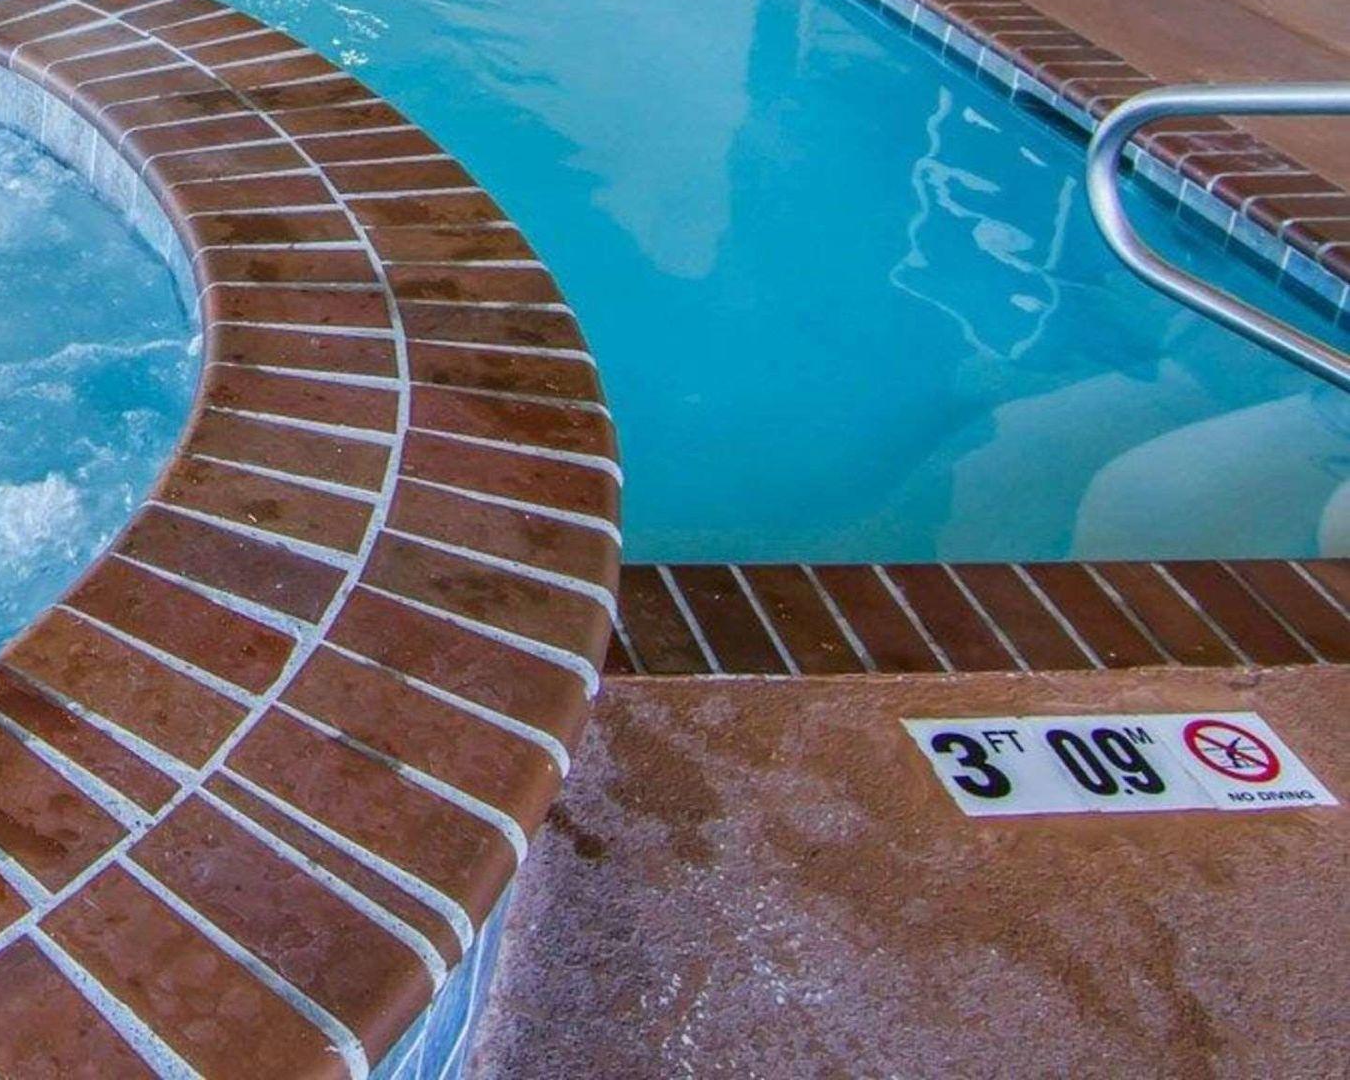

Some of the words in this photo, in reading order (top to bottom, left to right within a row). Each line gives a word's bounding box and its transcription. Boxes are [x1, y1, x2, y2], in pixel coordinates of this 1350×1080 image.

[931, 732, 1012, 798] 3
[981, 729, 1025, 753] FT
[1123, 726, 1155, 745] M
[1227, 791, 1256, 802] NO
[1256, 789, 1316, 802] DIVING
